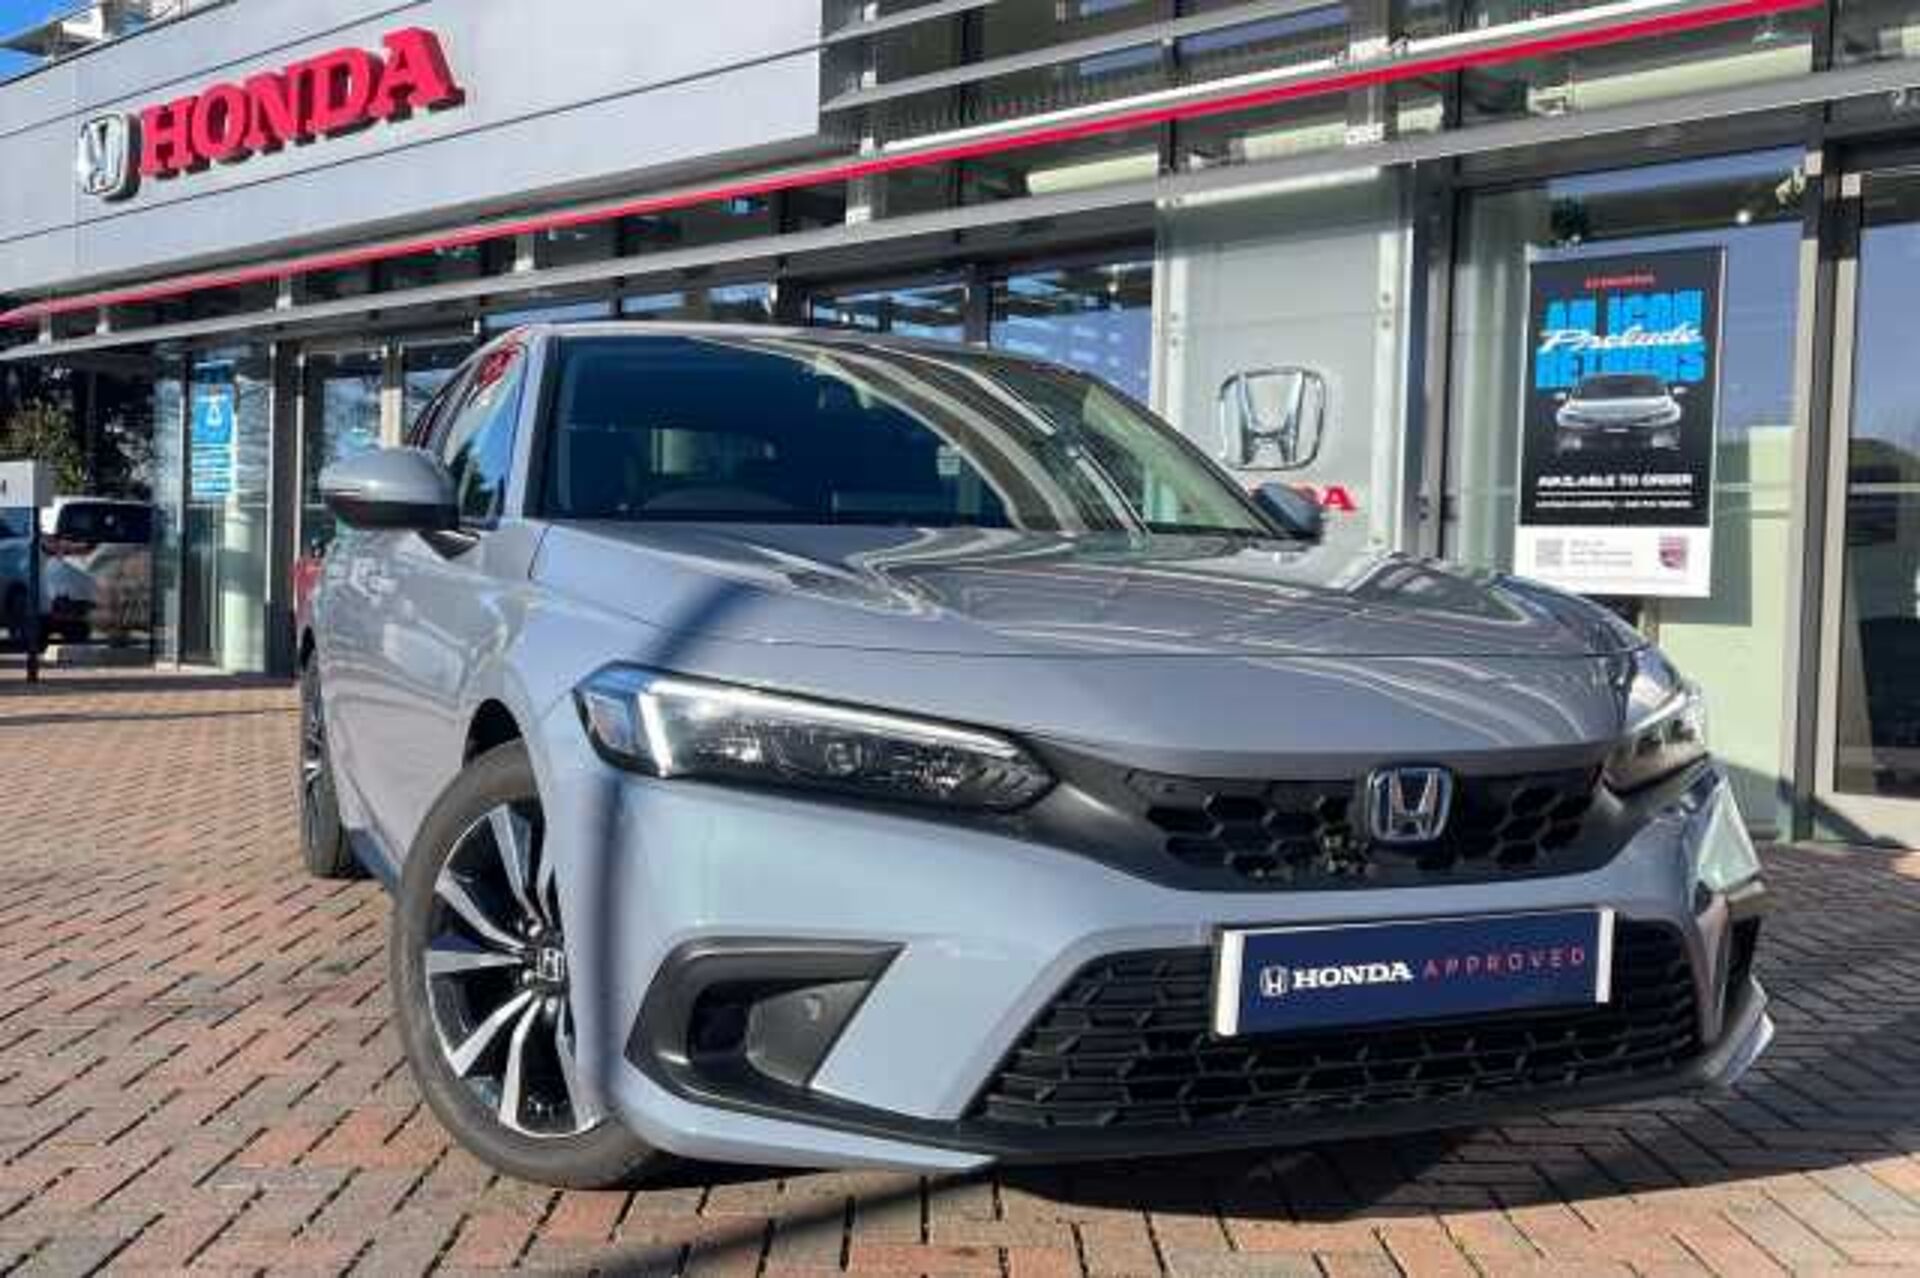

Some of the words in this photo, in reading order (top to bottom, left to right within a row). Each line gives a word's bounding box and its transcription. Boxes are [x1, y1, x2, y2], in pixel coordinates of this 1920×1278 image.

[139, 26, 464, 178] HONDA
[1540, 321, 1703, 353] Prelude
[1537, 475, 1614, 487] AVAILABLE
[1619, 474, 1639, 486] TO
[1293, 962, 1414, 989] HONDA
[1424, 946, 1585, 979] APPROVED
